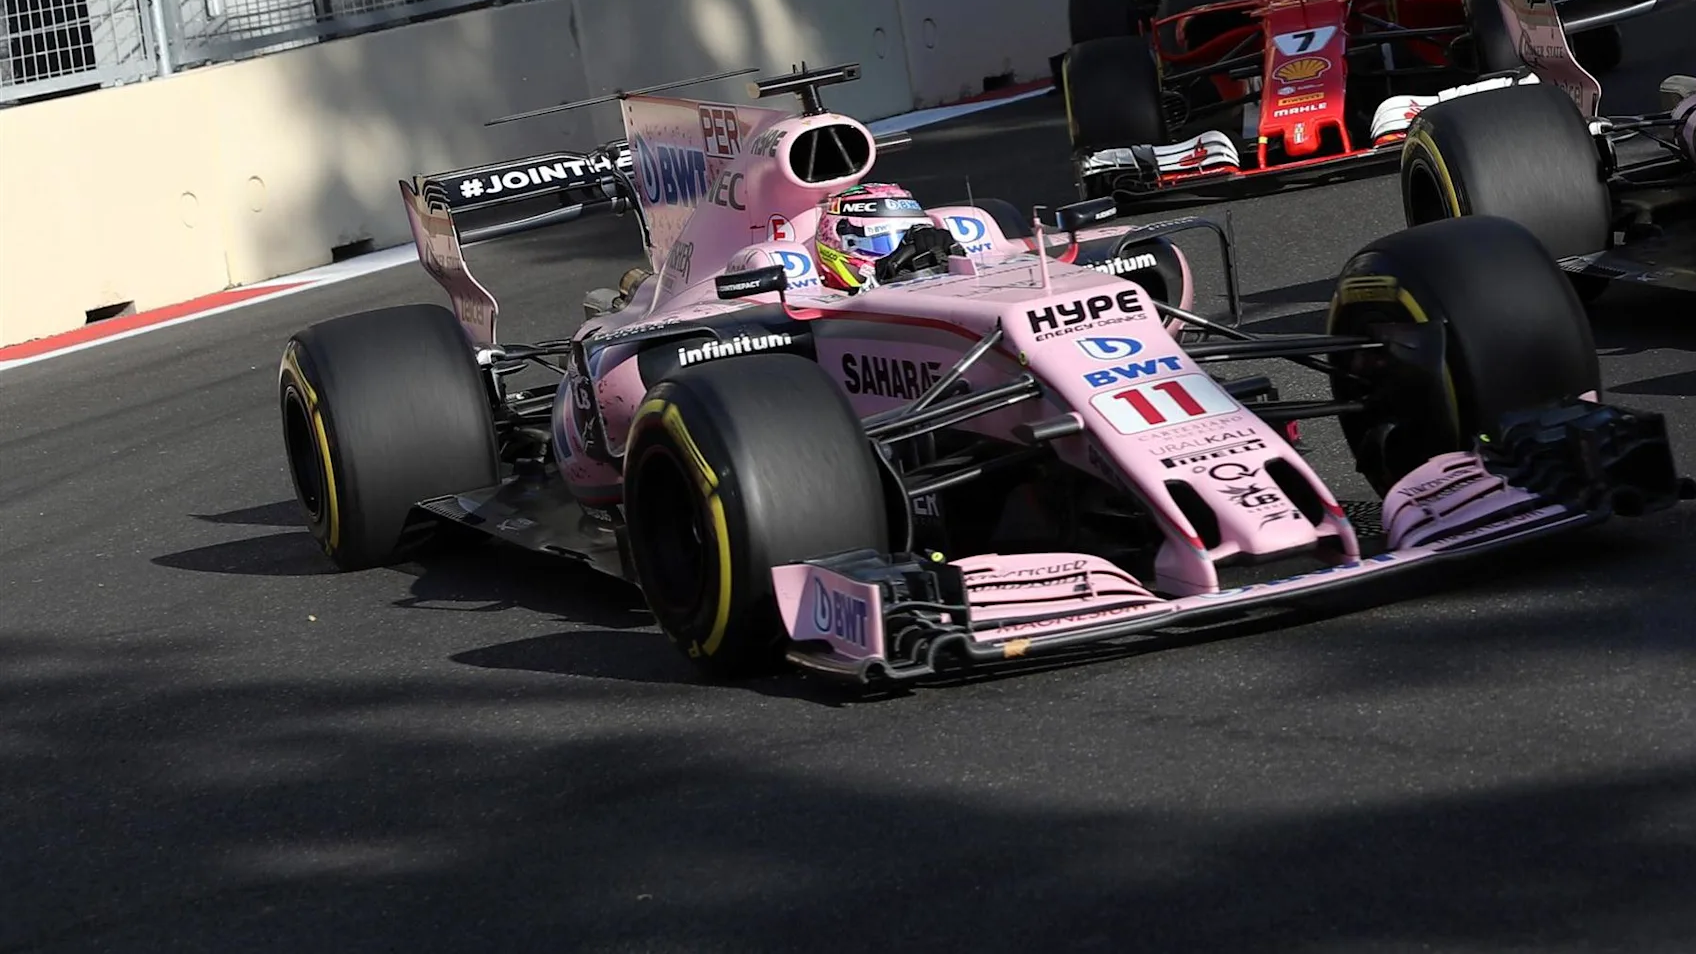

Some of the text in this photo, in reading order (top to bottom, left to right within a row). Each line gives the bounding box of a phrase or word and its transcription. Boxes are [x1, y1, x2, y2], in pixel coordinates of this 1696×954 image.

[1292, 31, 1316, 52] 7
[1274, 102, 1328, 117] MAHLE
[700, 109, 741, 156] PER
[657, 145, 708, 207] BWT
[843, 201, 877, 214] NEC
[1026, 288, 1144, 334] HYPE
[1034, 313, 1148, 342] ENERGY DRINKS
[677, 332, 793, 367] infinitum
[841, 352, 932, 400] SAHARA
[1083, 356, 1183, 388] BWT
[1112, 380, 1207, 426] 11
[1149, 428, 1257, 456] URALKALI
[834, 588, 868, 647] BWT
